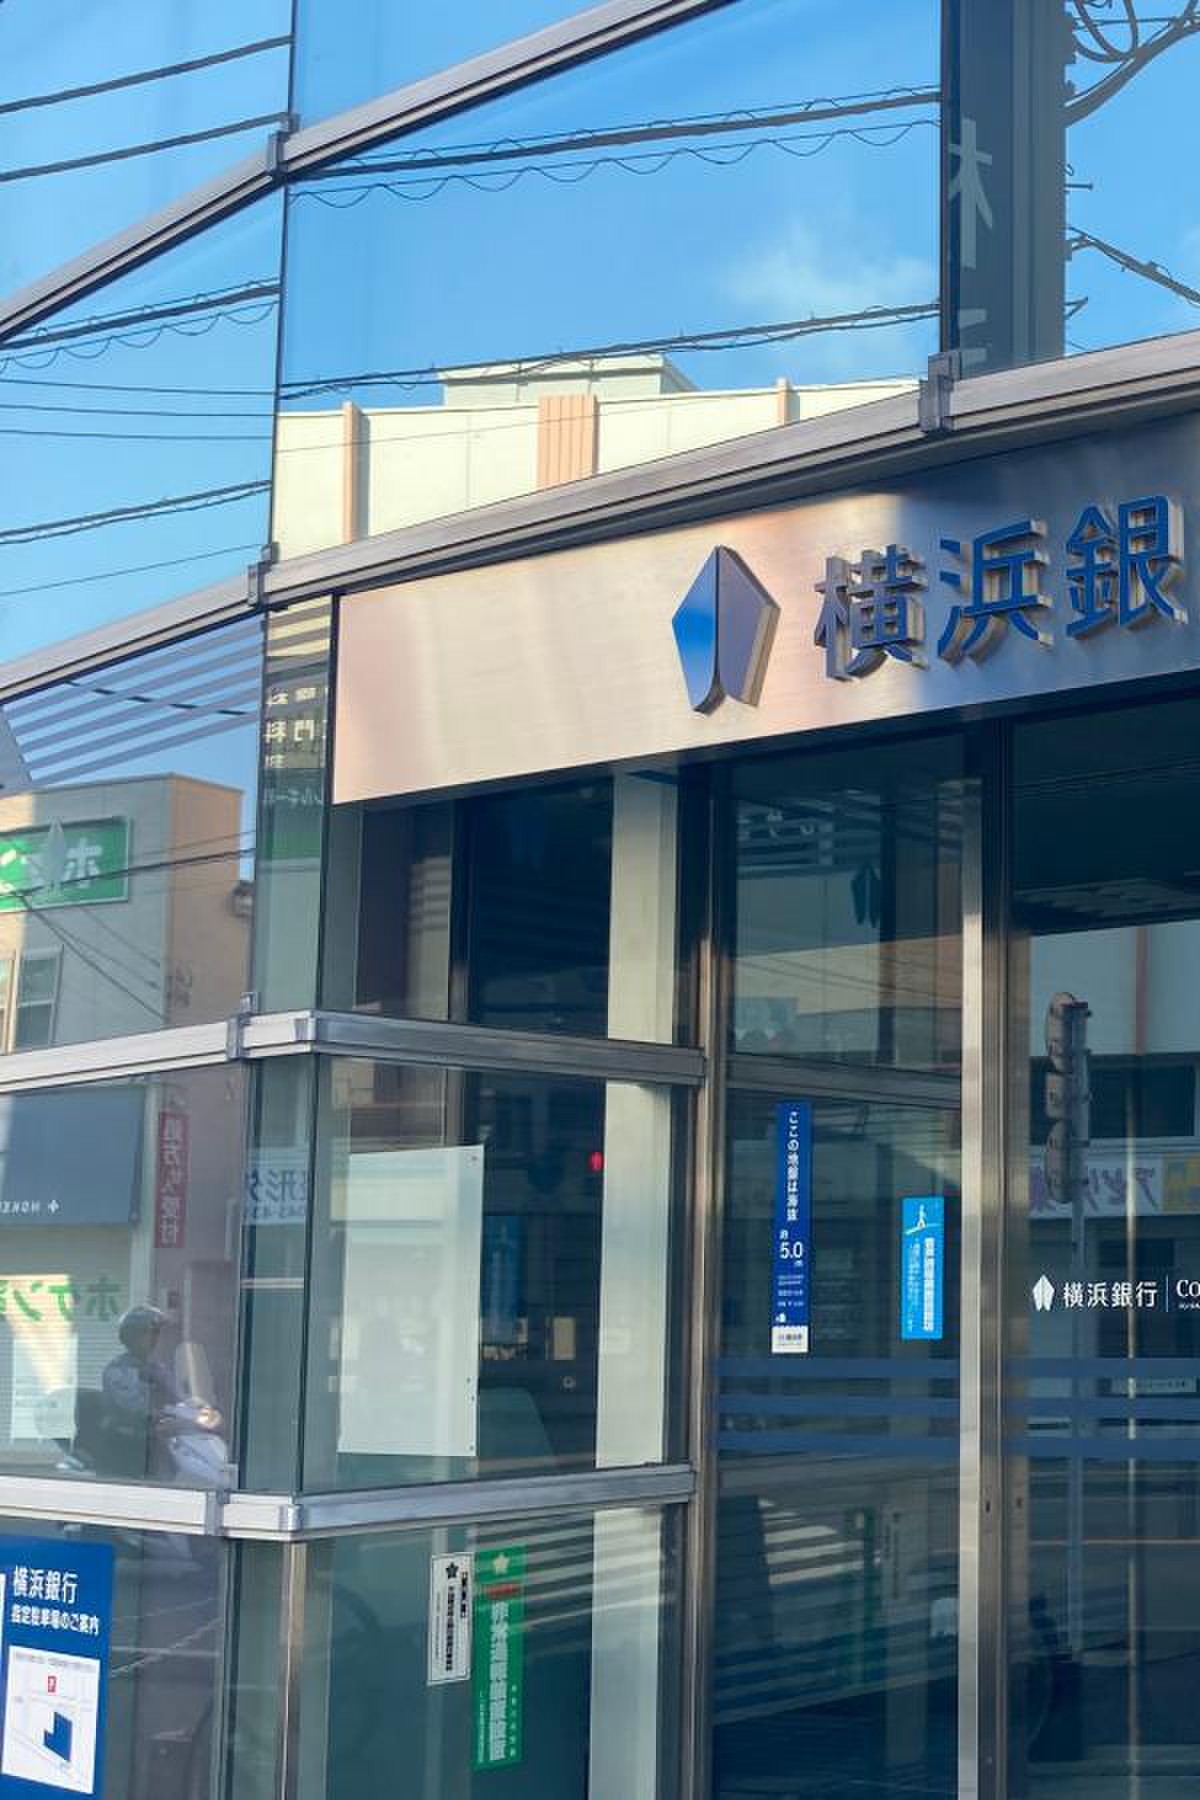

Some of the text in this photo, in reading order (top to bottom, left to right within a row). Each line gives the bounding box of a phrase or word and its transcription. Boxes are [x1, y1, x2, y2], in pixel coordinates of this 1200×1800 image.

[780, 1241, 803, 1259] 5.0
[1063, 1281, 1158, 1308] 横浜銀行
[12, 1564, 78, 1605] 横浜銀行
